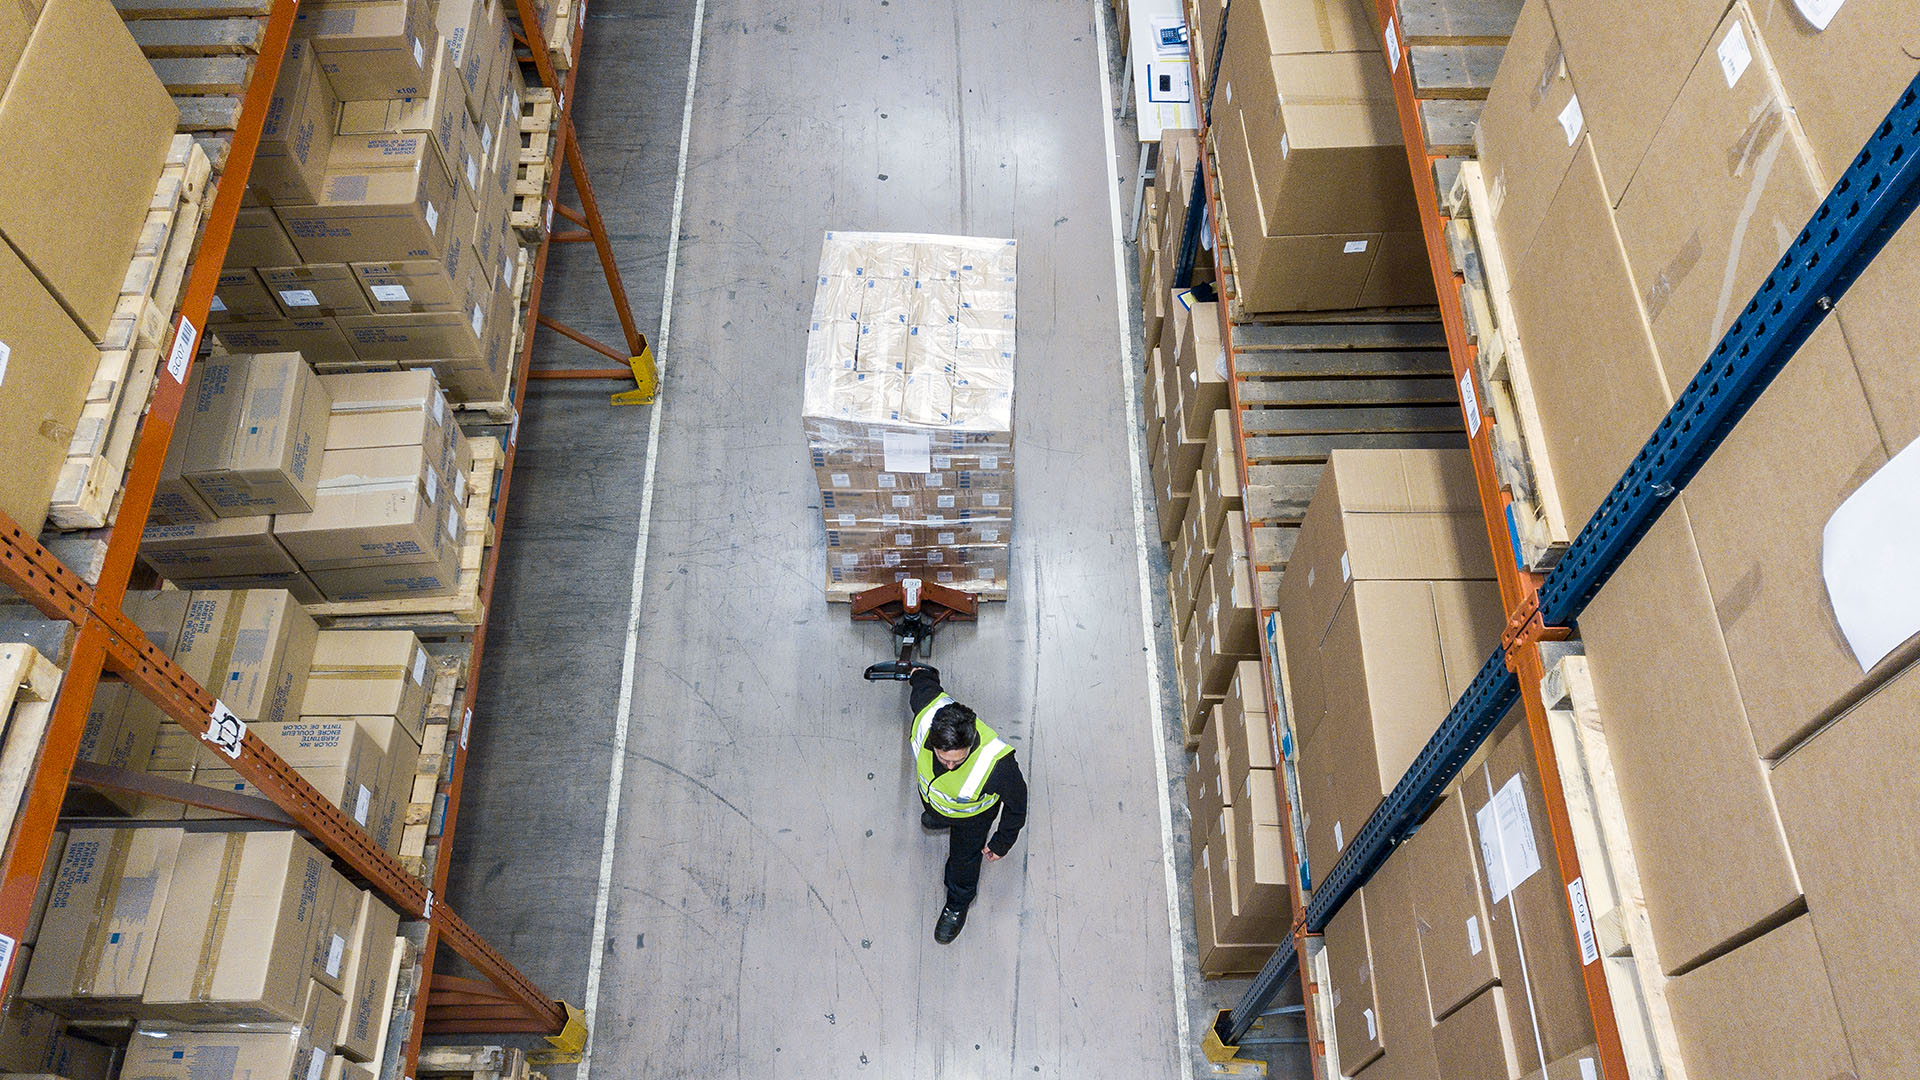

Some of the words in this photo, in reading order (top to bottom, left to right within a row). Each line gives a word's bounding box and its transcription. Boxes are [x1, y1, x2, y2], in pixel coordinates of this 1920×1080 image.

[172, 343, 184, 376] GC07
[67, 843, 77, 864] TINTA
[72, 842, 85, 867] ENCRE
[74, 842, 92, 883] FARBTINTE
[88, 842, 99, 868] COLOR
[62, 867, 70, 877] DE
[82, 872, 90, 884] INK
[53, 881, 65, 908] COLOR
[60, 872, 76, 908] COULEUR
[1574, 881, 1586, 923] FC06
